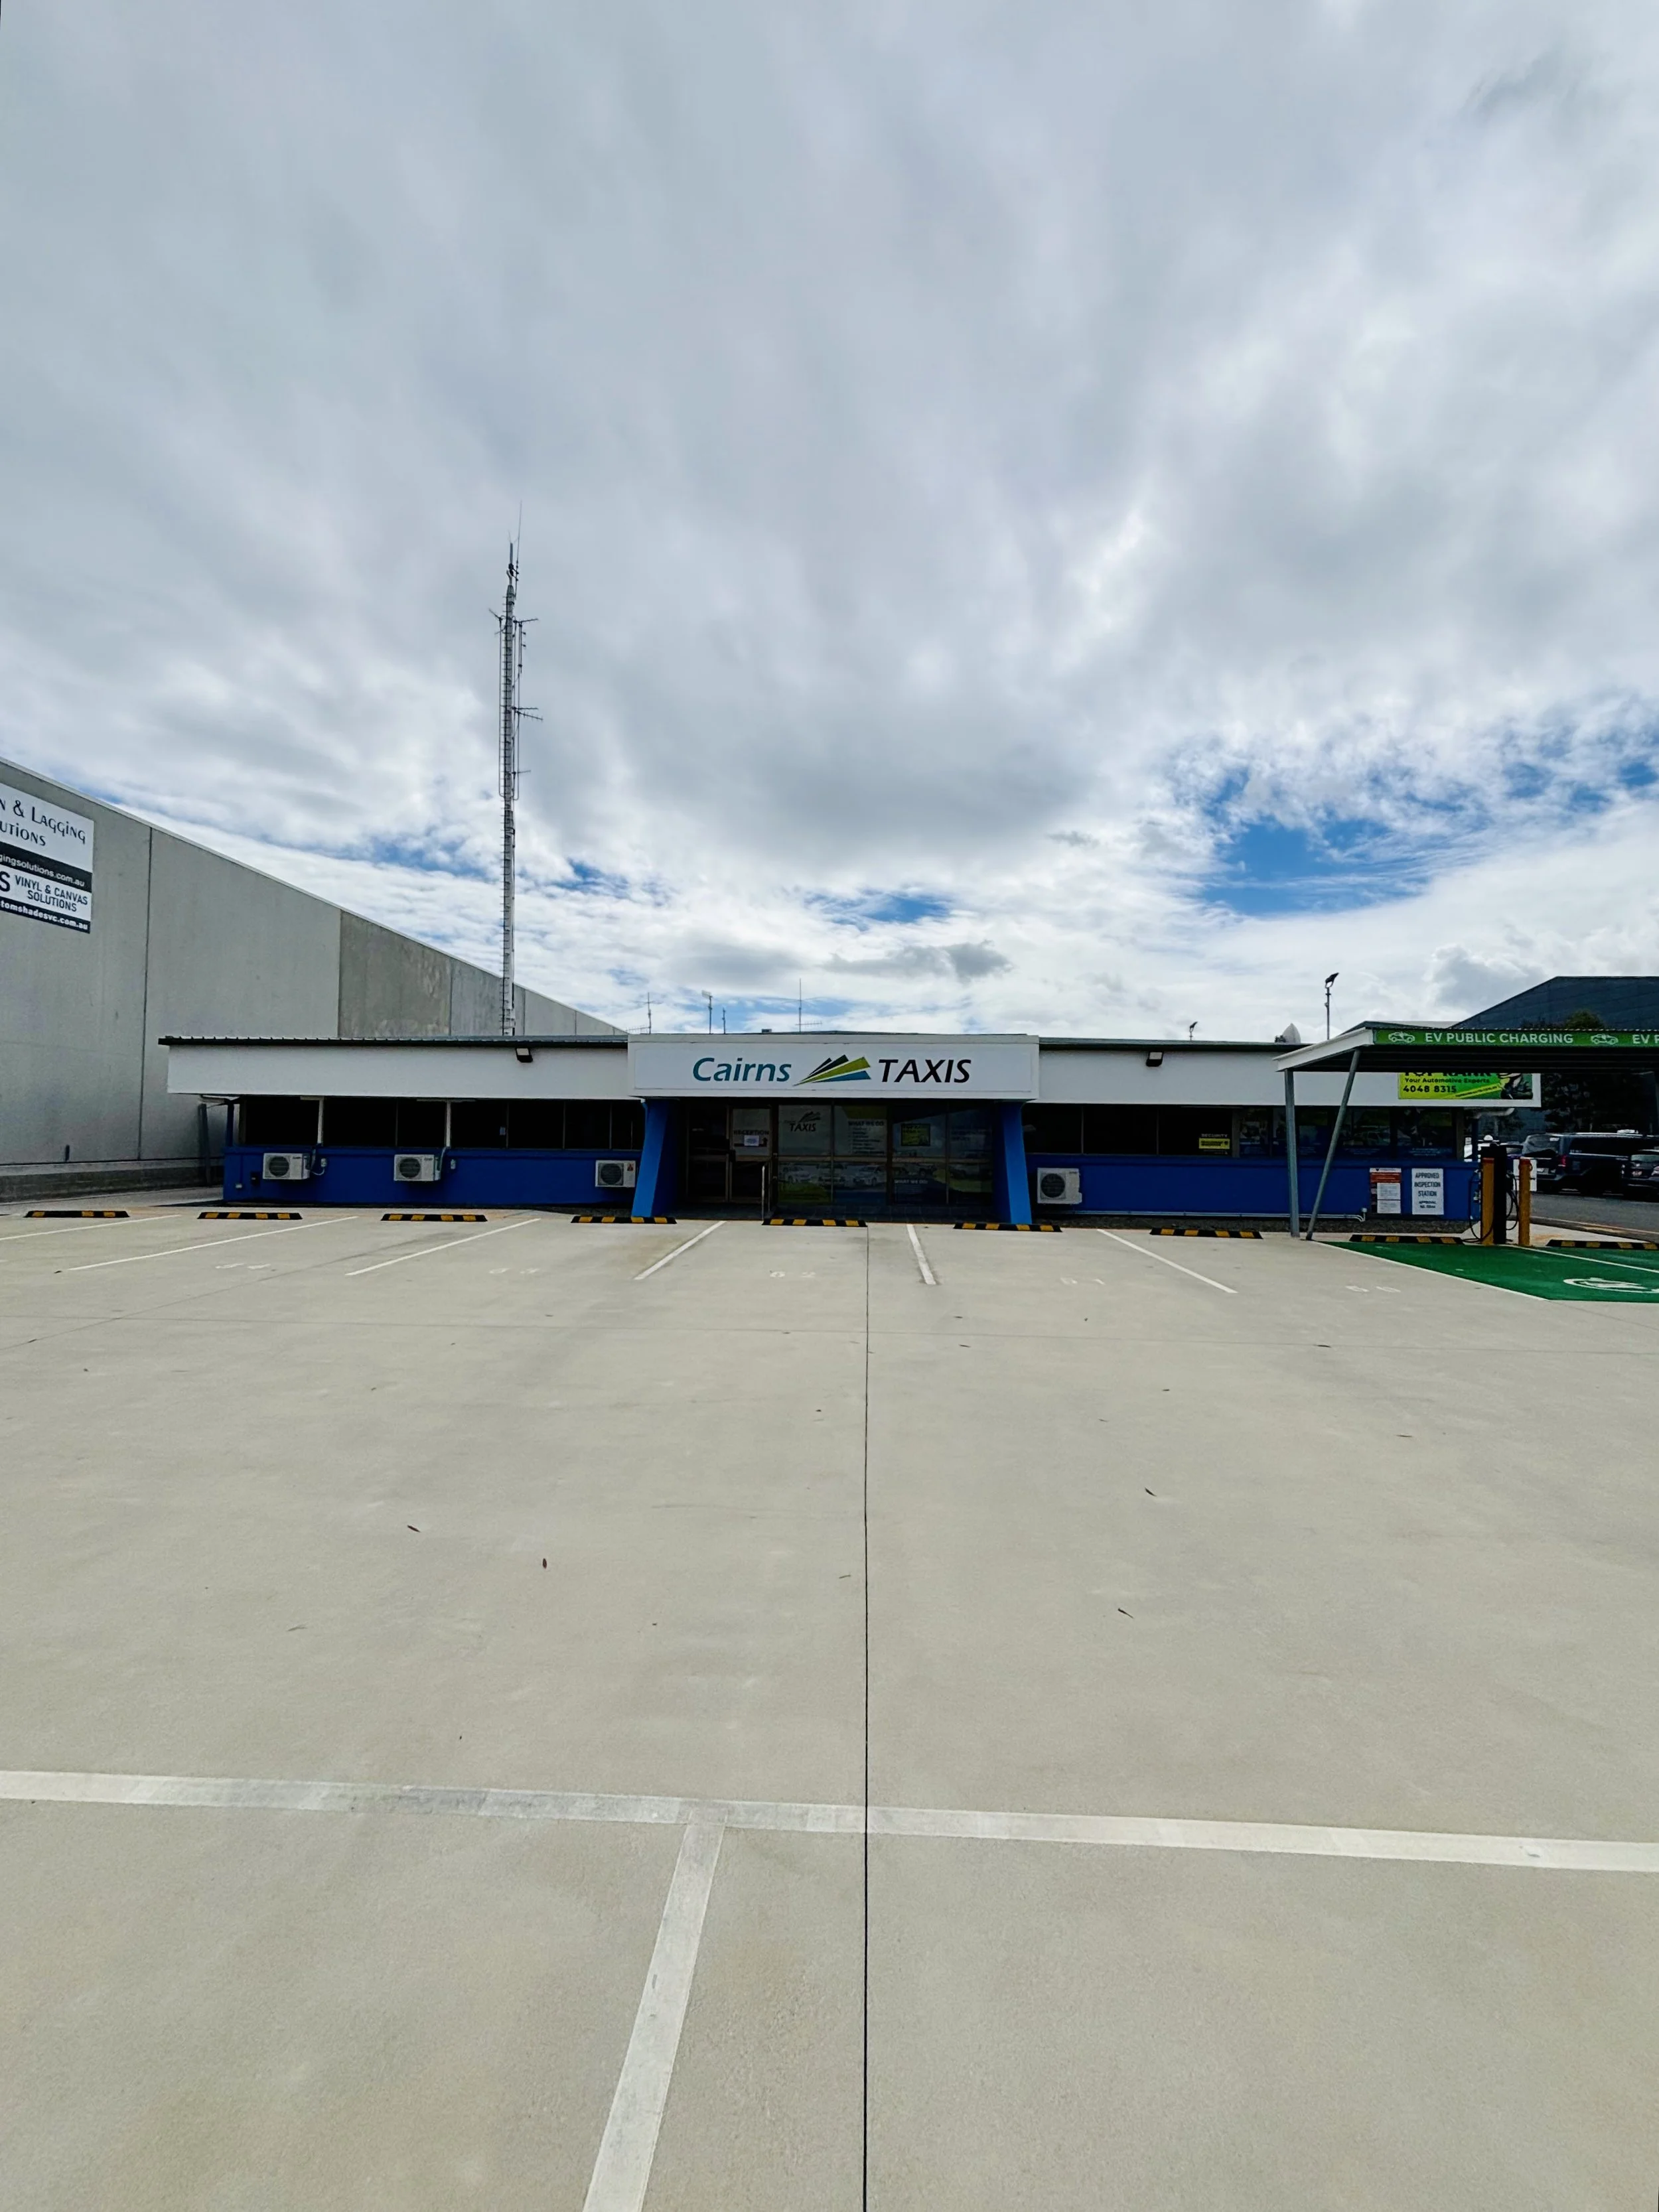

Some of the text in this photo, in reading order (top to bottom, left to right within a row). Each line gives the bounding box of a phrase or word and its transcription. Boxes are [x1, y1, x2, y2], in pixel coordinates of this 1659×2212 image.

[13, 800, 25, 818] &
[15, 874, 88, 905] VINYL & CANVAS
[27, 890, 77, 912] SOLUTIONS
[1425, 1032, 1573, 1044] EV PUBLIC CHARGING
[1632, 1034, 1650, 1044] EV
[693, 1057, 972, 1083] Cairns TAXIS
[789, 1123, 816, 1132] TAXIS
